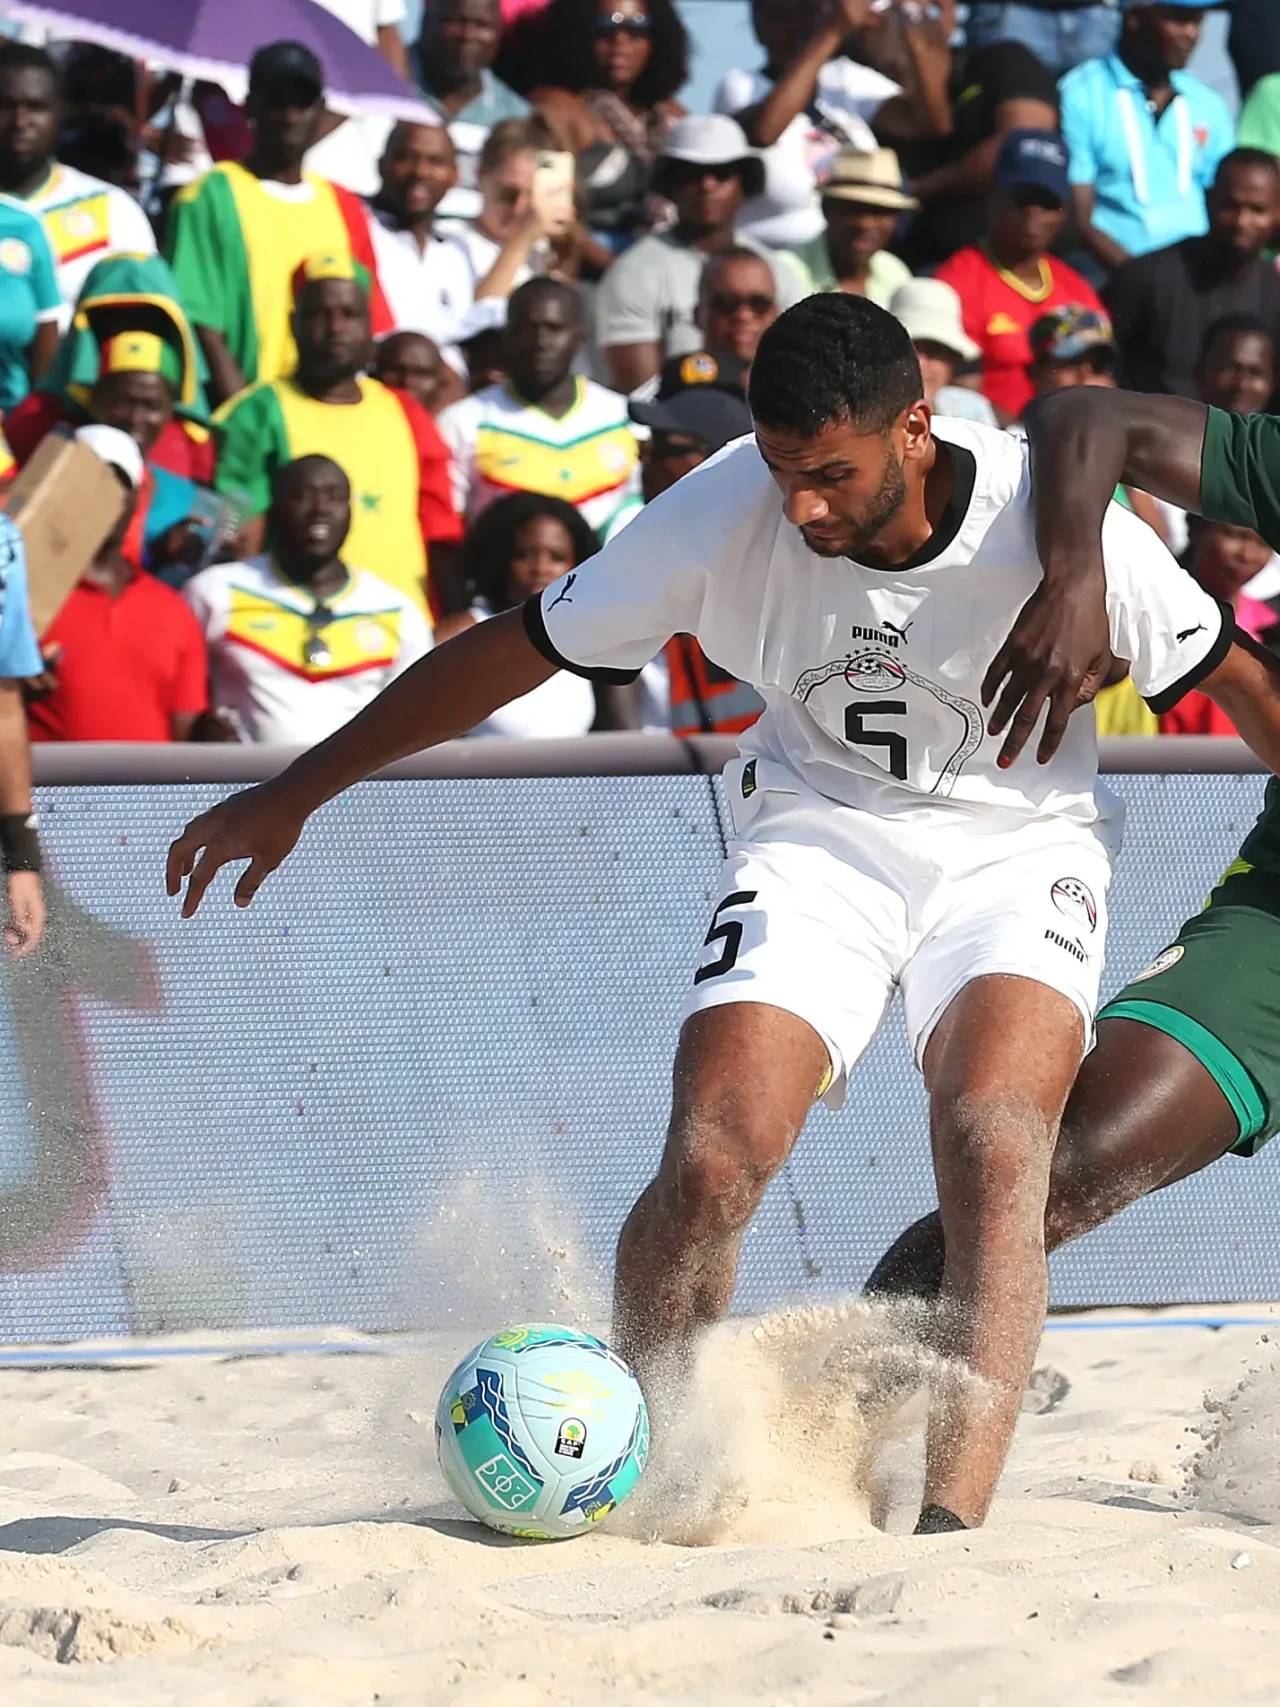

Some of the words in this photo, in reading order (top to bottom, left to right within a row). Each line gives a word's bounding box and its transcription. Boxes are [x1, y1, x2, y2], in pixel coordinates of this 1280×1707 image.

[851, 625, 899, 648] PUMA
[844, 700, 908, 781] 5
[694, 890, 759, 985] 5
[1044, 929, 1085, 963] PUMA
